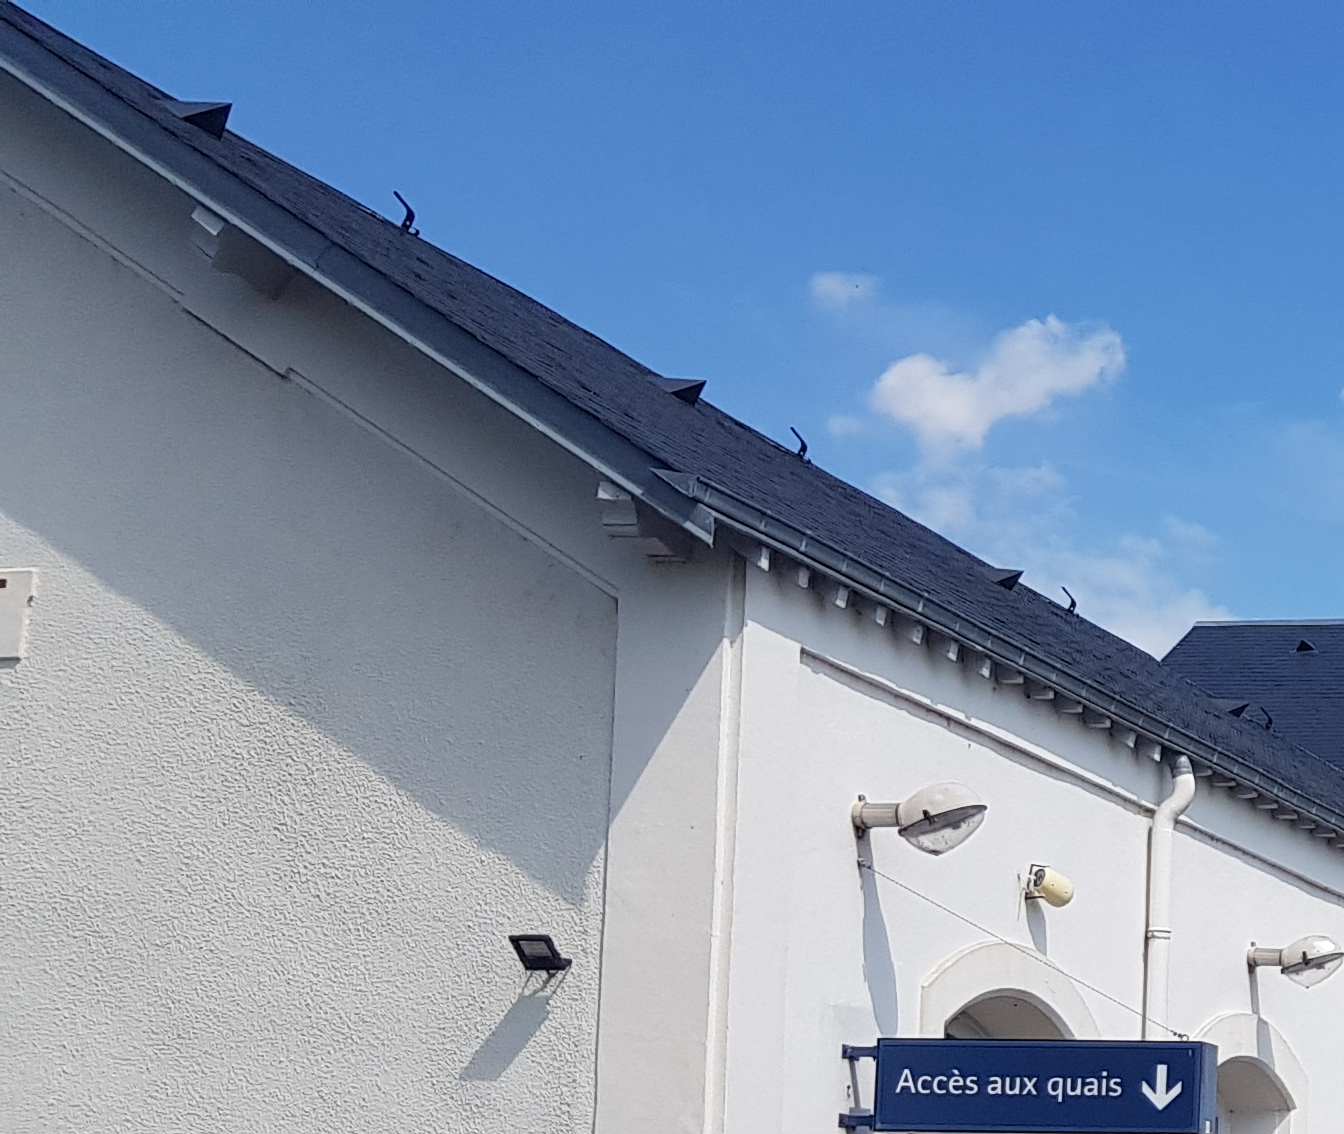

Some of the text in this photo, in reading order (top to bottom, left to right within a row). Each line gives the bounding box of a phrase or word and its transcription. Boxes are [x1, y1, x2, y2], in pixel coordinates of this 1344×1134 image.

[895, 1068, 1123, 1103] Accès aux quais
